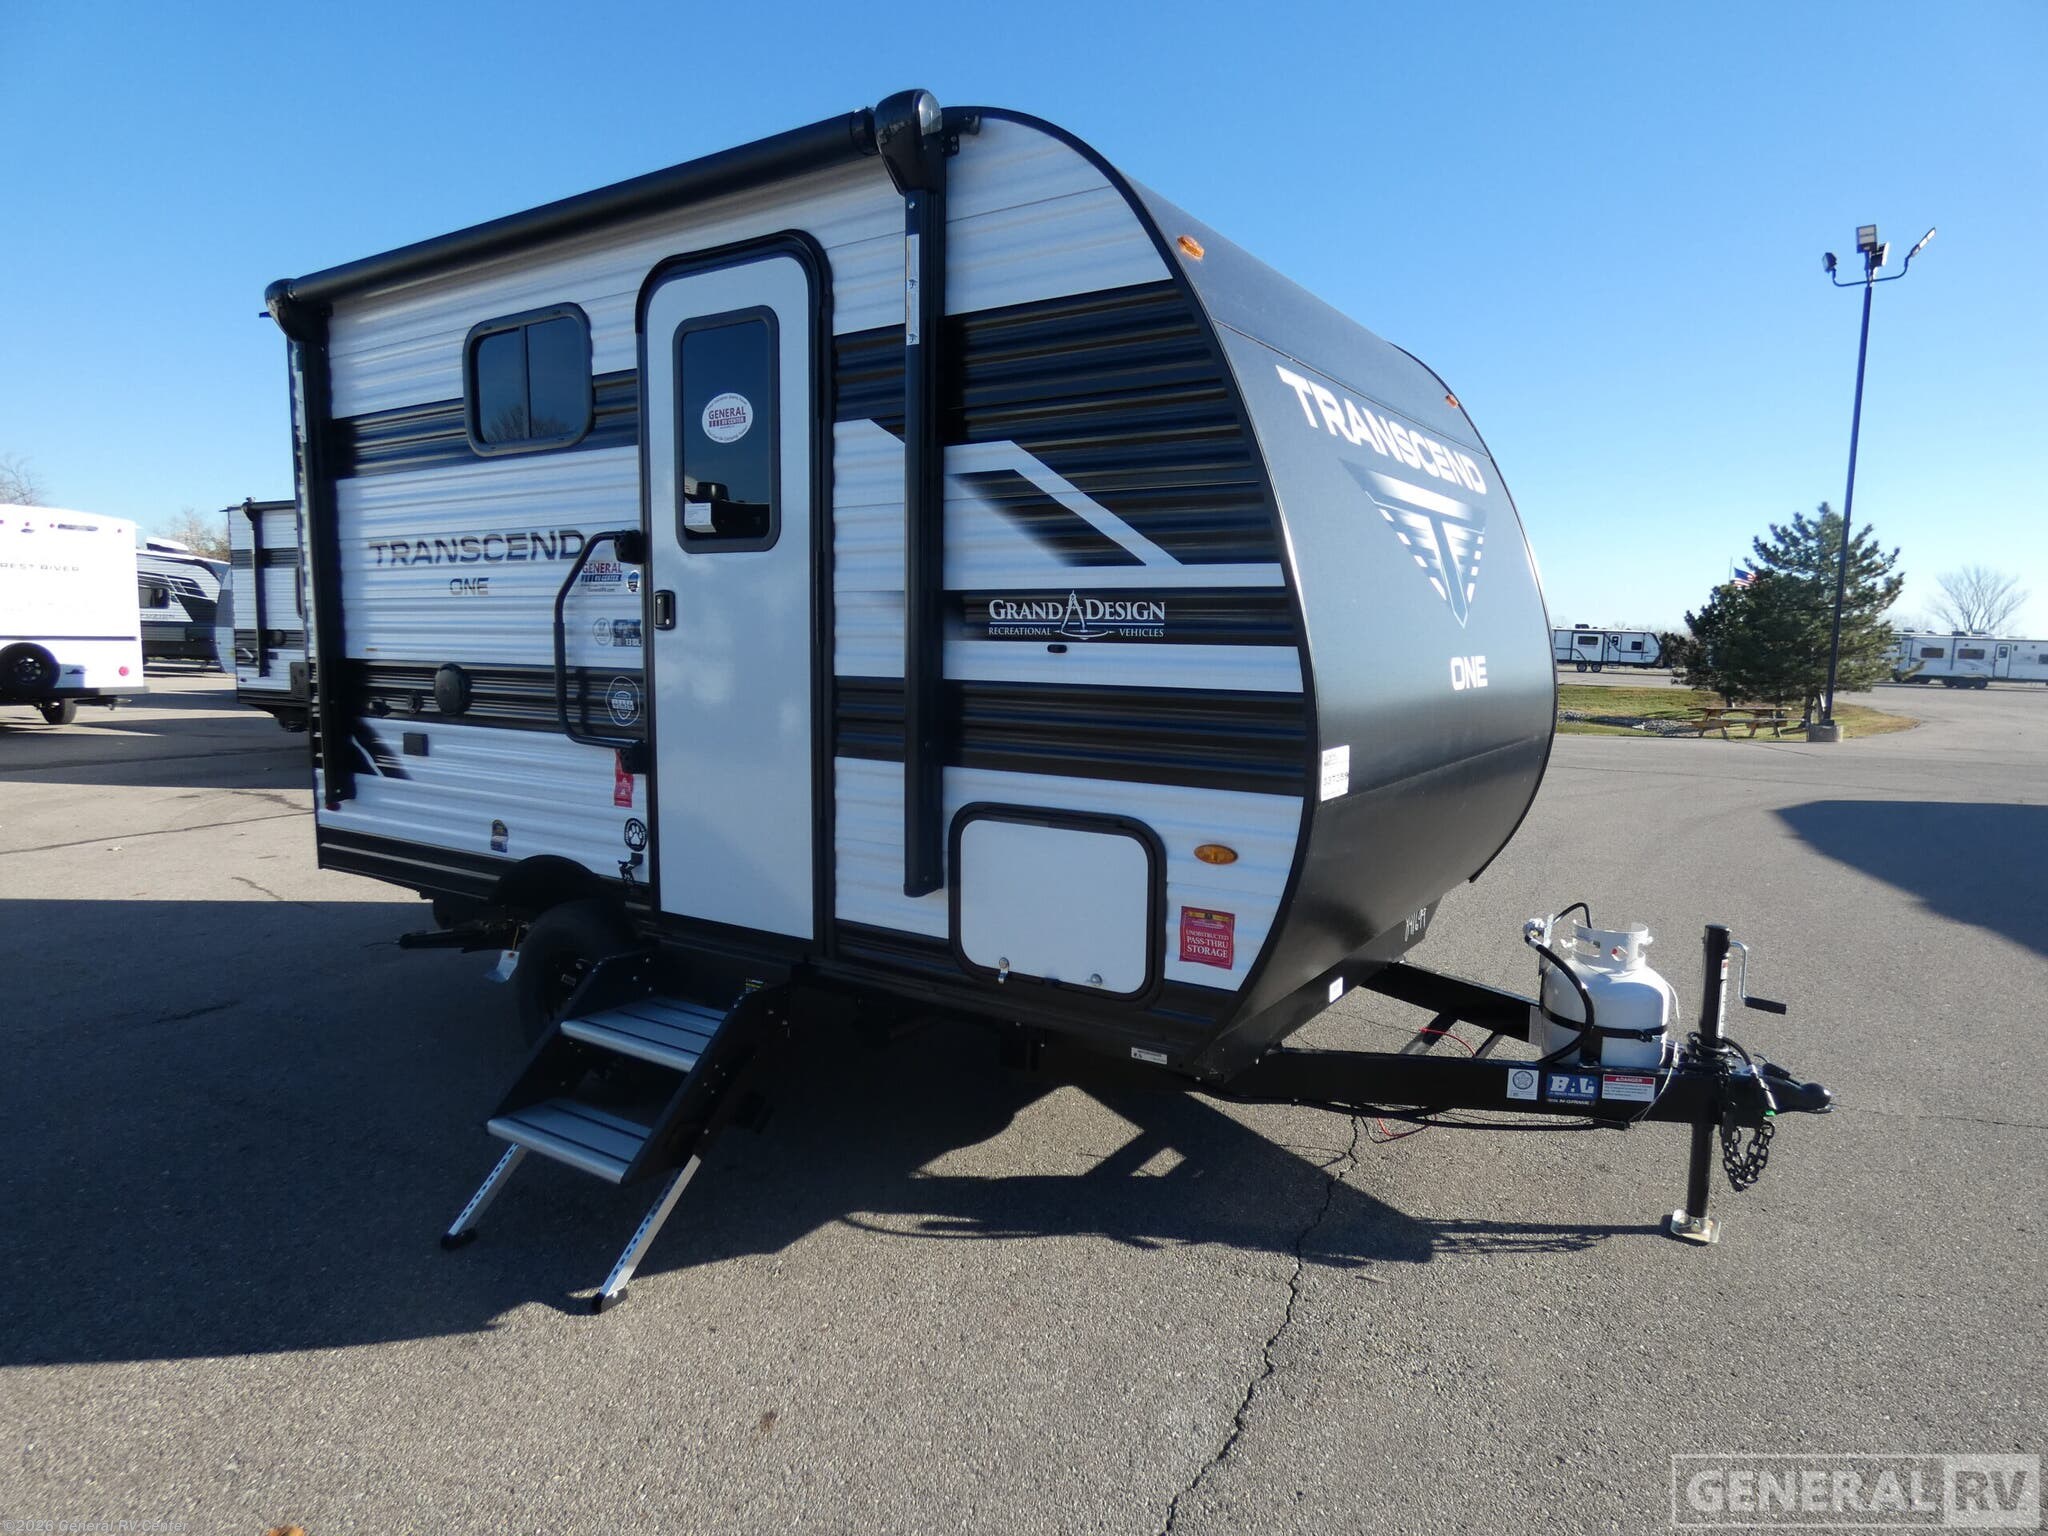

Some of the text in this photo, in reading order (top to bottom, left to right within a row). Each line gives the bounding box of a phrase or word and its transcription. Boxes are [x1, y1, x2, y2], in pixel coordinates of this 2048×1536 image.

[708, 406, 746, 420] GENERAL
[1275, 364, 1489, 495] TRANSCEND
[368, 529, 586, 567] TRANSCEND
[582, 562, 623, 574] GENERAL
[449, 577, 489, 597] ONE
[988, 626, 1164, 638] RECREATIONAL VEHICLES
[1450, 655, 1489, 691] ONE
[1185, 929, 1230, 941] UNOBSTRUCTED
[1186, 935, 1229, 948] PASS-THRU
[1186, 944, 1228, 958] STORAGE
